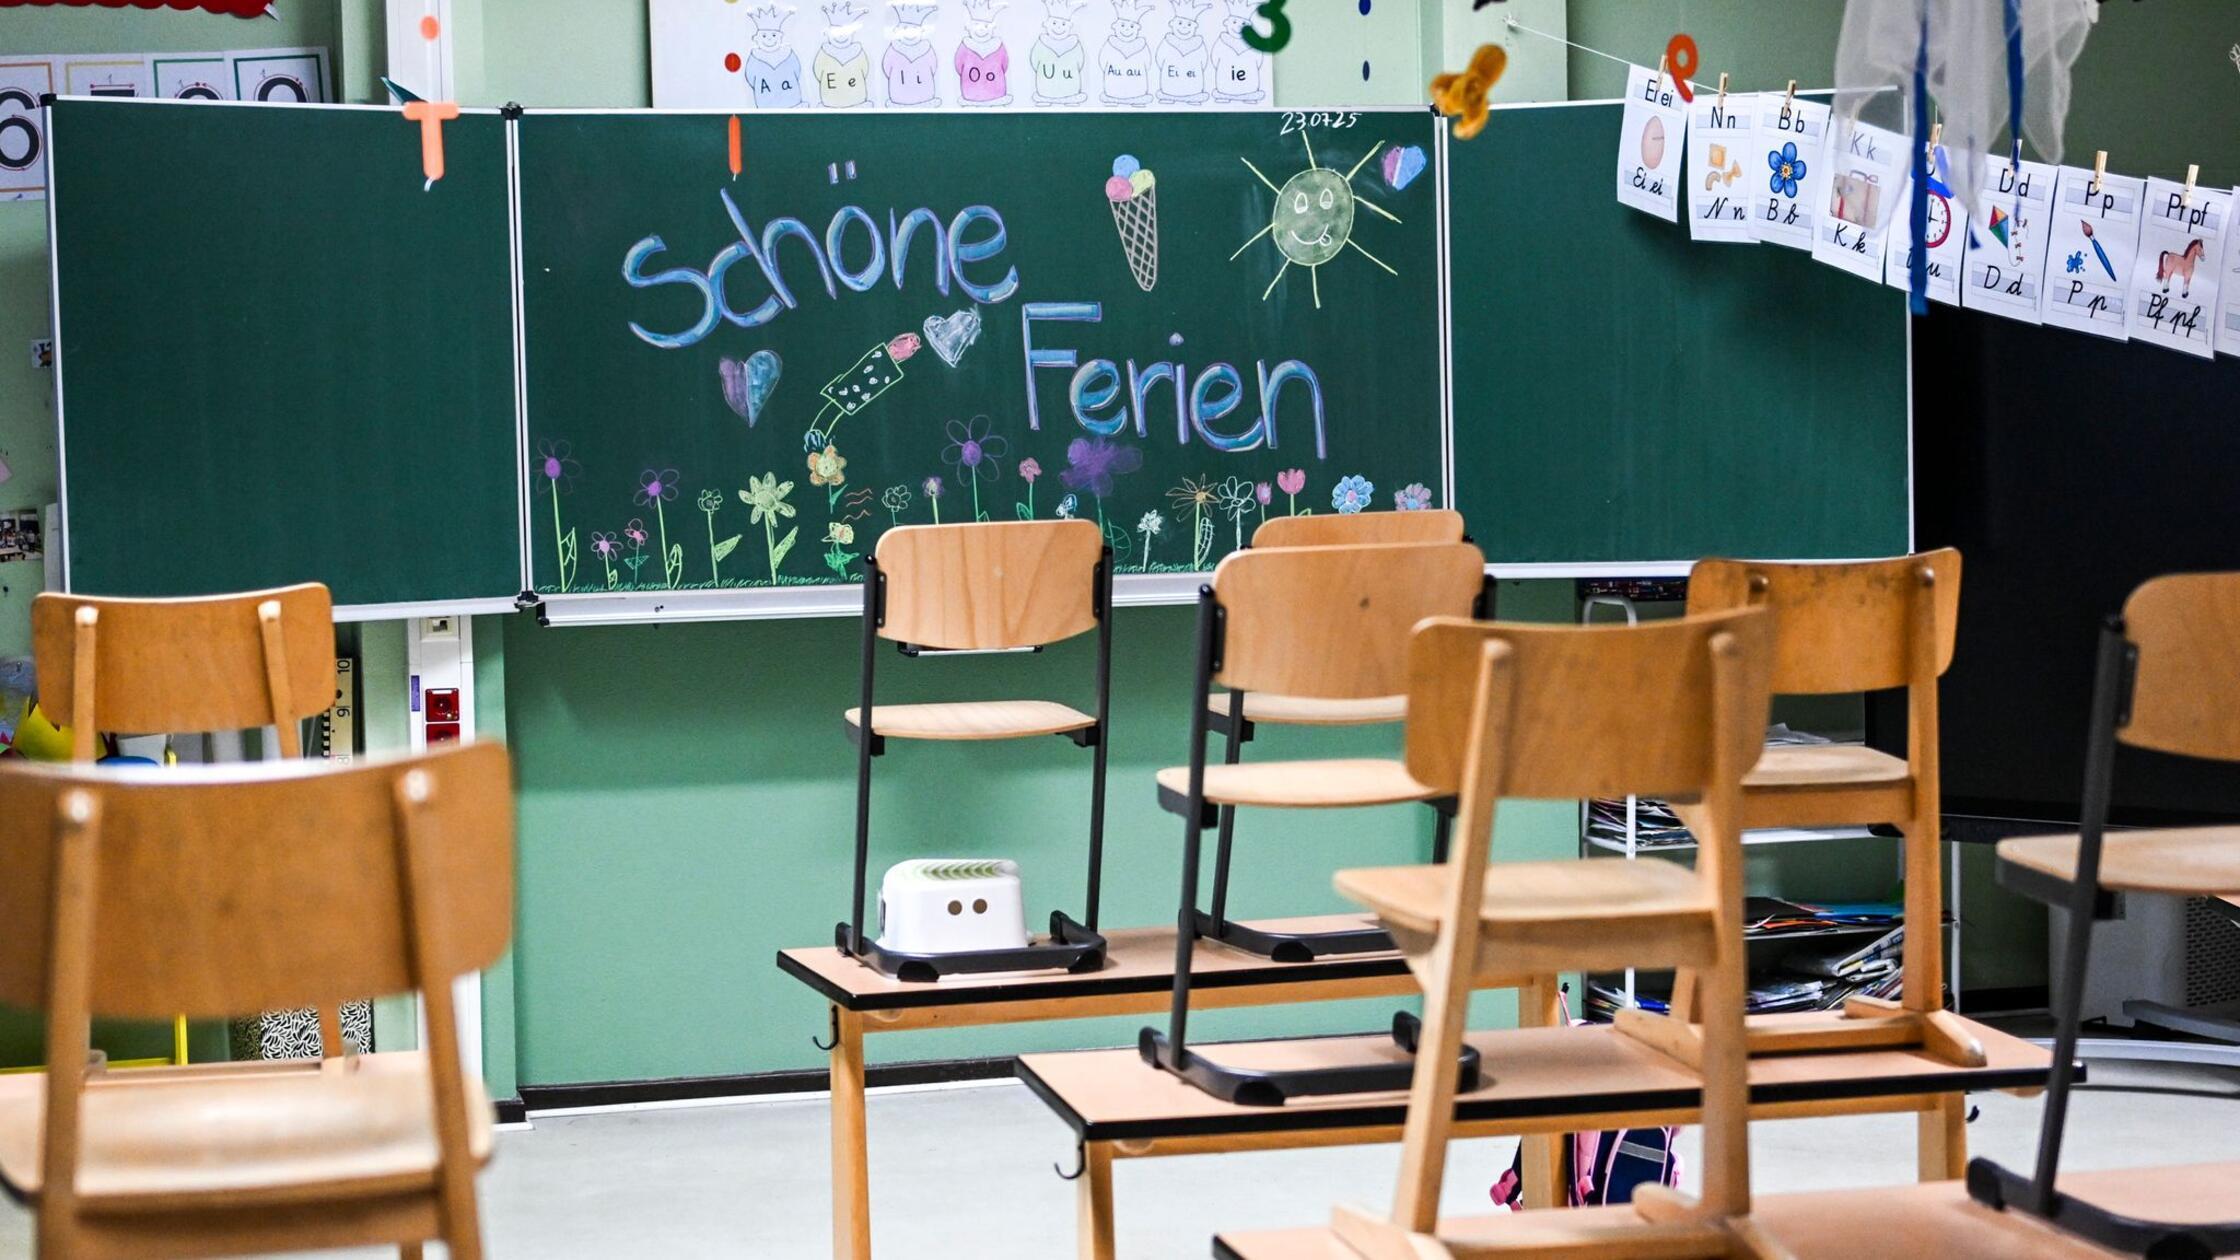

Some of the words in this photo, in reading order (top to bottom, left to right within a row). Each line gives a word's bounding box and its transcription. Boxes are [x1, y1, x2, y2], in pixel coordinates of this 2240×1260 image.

[1042, 64, 1055, 80] U
[1062, 68, 1073, 79] u
[1107, 65, 1122, 77] Au
[1126, 68, 1142, 77] au
[1231, 66, 1246, 81] ie
[760, 78, 771, 94] A
[781, 80, 793, 91] a
[826, 73, 836, 89] E
[848, 77, 857, 88] e
[1632, 166, 1647, 190] Ei
[1649, 176, 1664, 196] ei
[621, 160, 1020, 350] Schöne
[1022, 301, 1327, 460] Ferien
